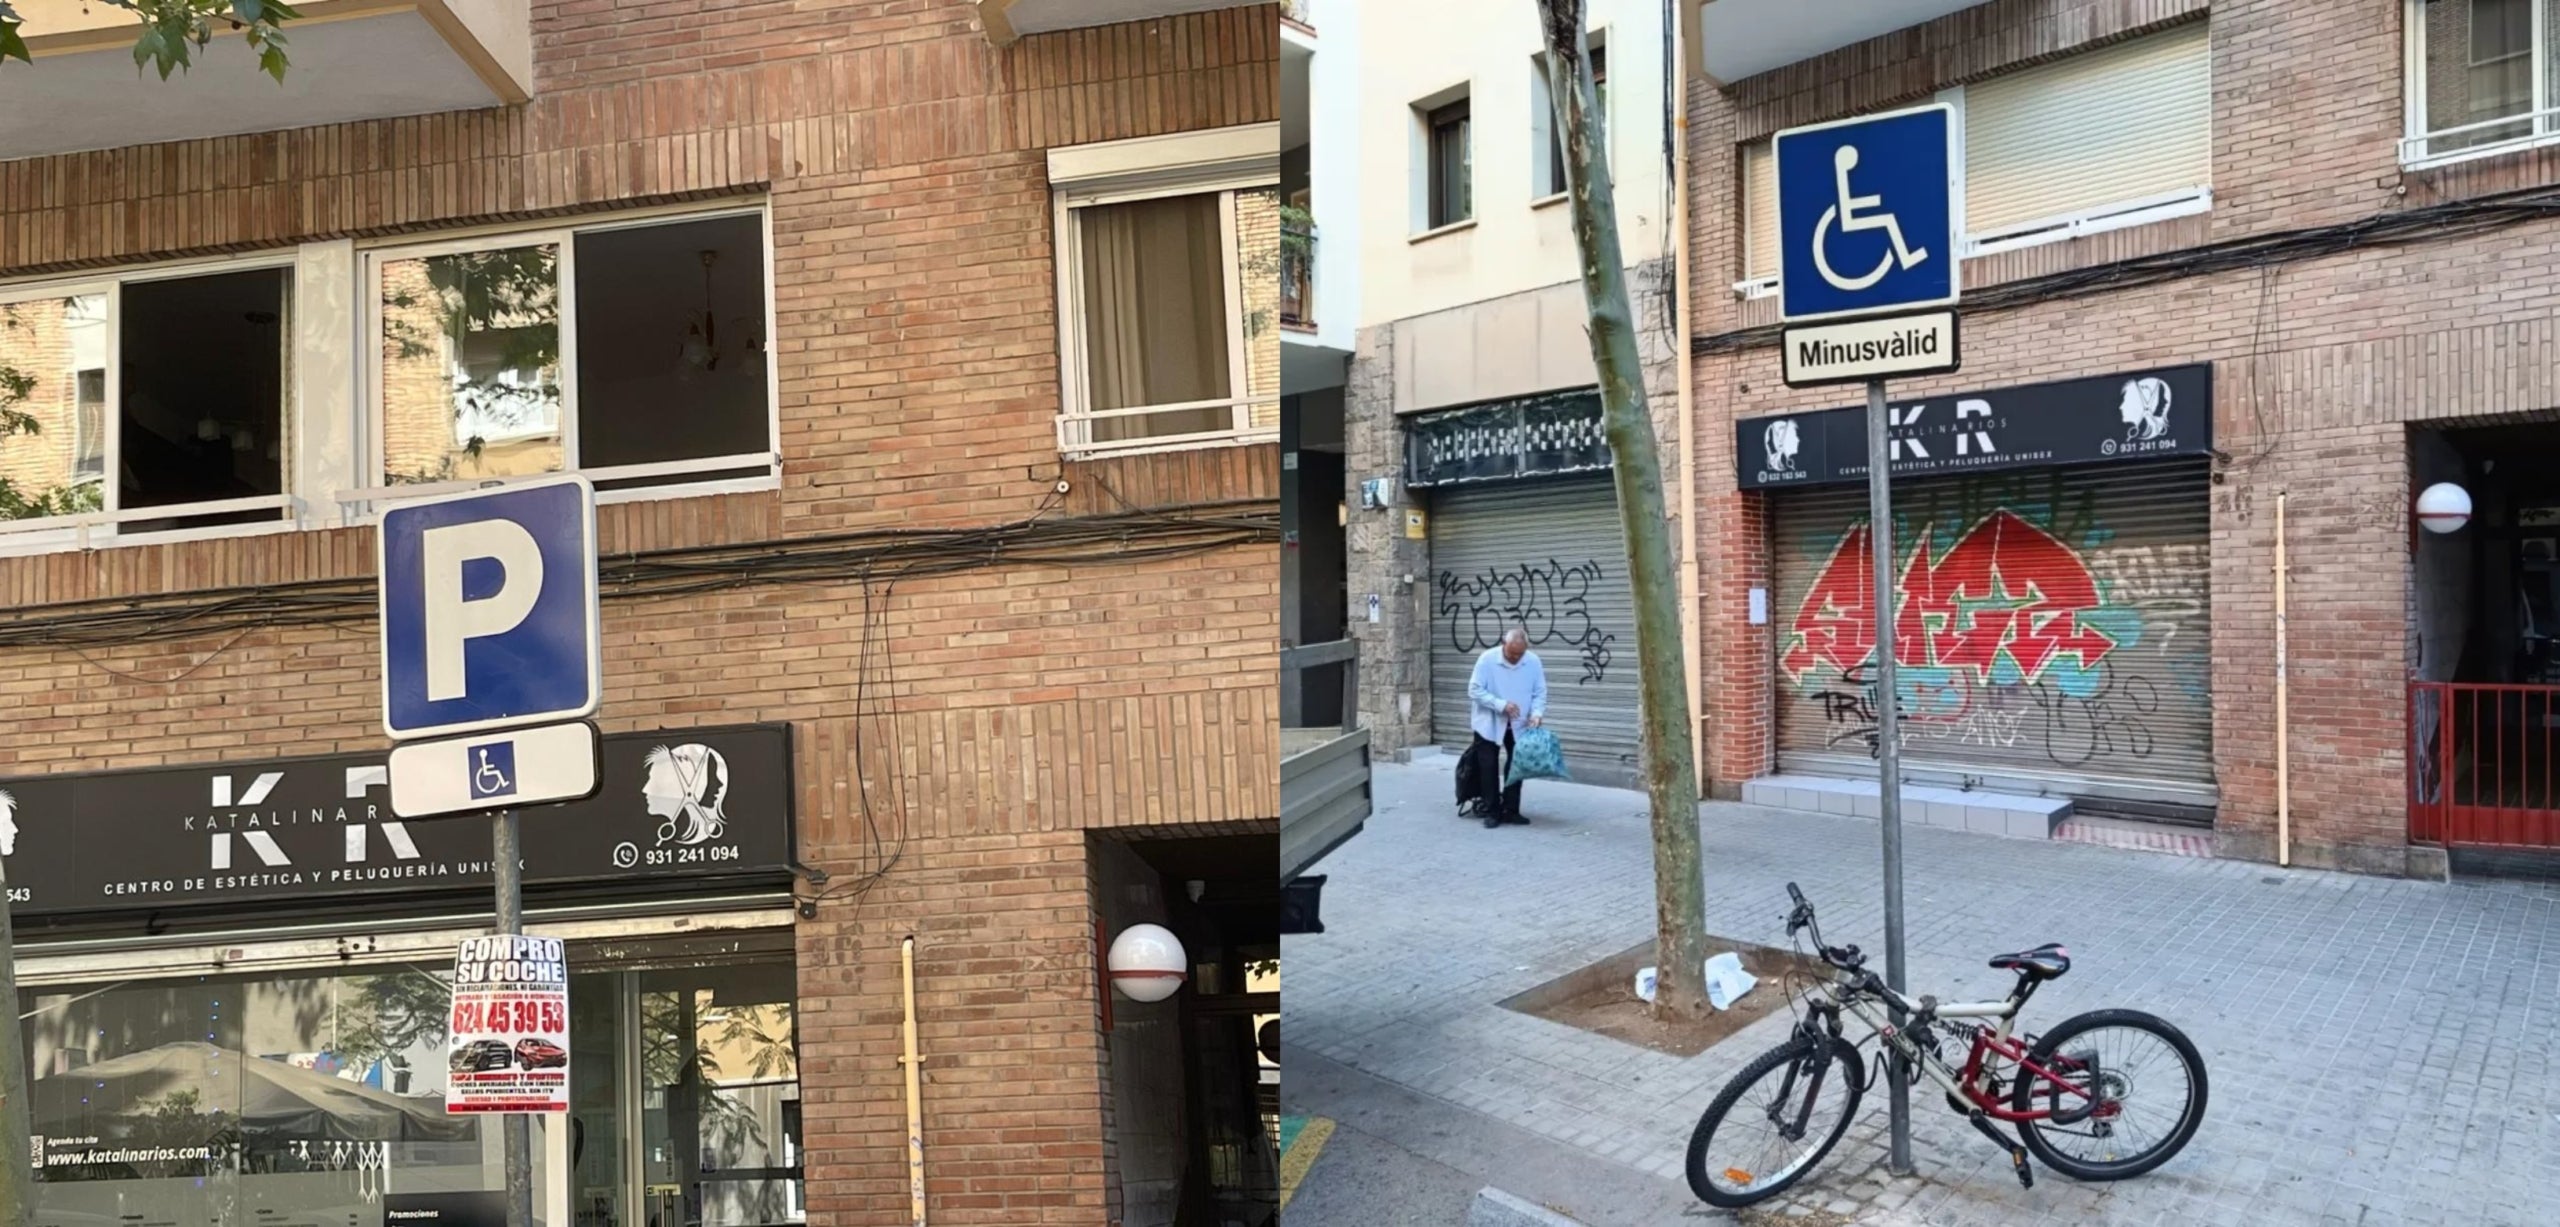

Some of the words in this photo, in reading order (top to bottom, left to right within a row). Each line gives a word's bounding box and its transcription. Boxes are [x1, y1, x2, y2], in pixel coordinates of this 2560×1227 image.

[1799, 326, 1938, 367] Minusvàlid
[1887, 422, 1958, 438] ATALINA
[1889, 404, 1930, 460] K
[1956, 399, 1996, 455] R
[2120, 442, 2136, 453] 931
[2140, 440, 2156, 451] 241
[2159, 439, 2176, 450] 094
[1949, 451, 2011, 466] PELUQUERÍA
[2014, 450, 2053, 461] UNISEX
[422, 518, 544, 702] P
[211, 771, 292, 870] K
[645, 849, 673, 865] 931
[678, 847, 705, 863] 241
[710, 845, 739, 861] 094
[104, 880, 174, 896] CENTRO
[183, 878, 205, 891] DE
[215, 871, 303, 888] ESTÉTICA
[312, 871, 321, 883] Y
[331, 861, 448, 882] PELUQUERÍA
[457, 859, 525, 874] UNIX
[6, 887, 31, 902] 543
[459, 938, 562, 963] COMPRO
[457, 961, 486, 983] SU
[488, 960, 564, 982] COCHE
[453, 1002, 484, 1034] 624
[487, 1001, 510, 1033] 45
[514, 1001, 538, 1033] 39
[542, 1001, 565, 1033] 53
[47, 1137, 74, 1147] Agenda
[75, 1137, 83, 1145] tu
[84, 1135, 98, 1145] cita
[47, 1145, 210, 1166] www.katalinarios.com
